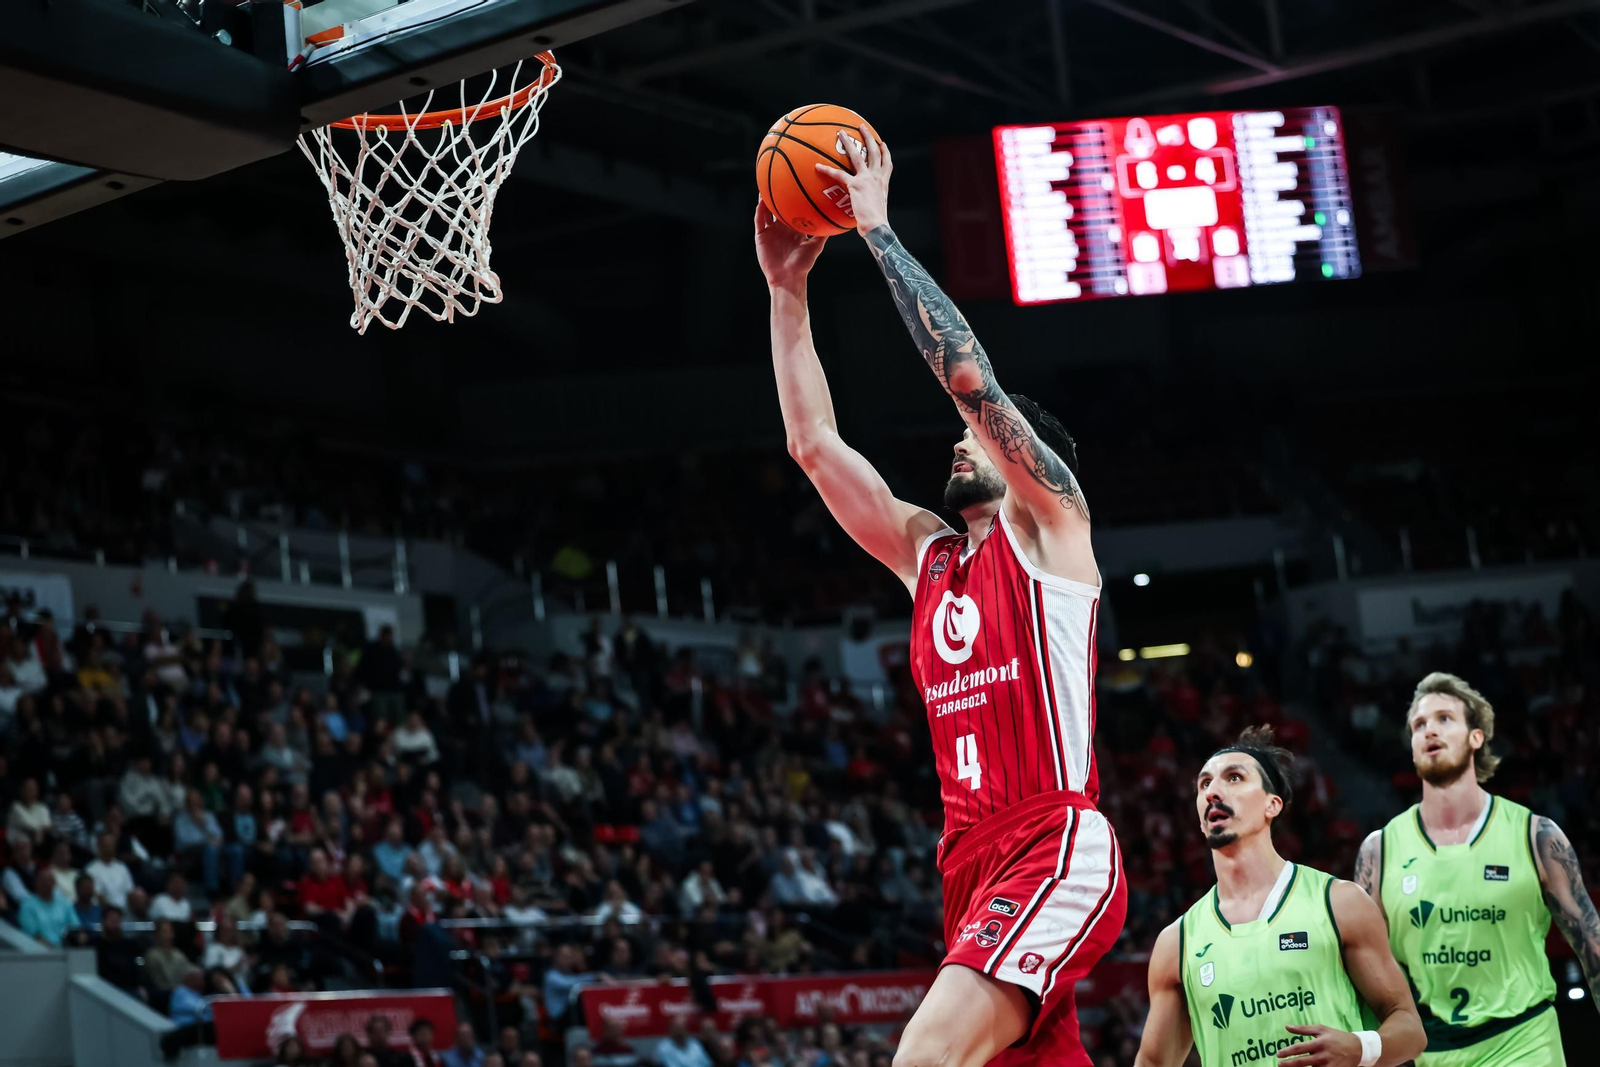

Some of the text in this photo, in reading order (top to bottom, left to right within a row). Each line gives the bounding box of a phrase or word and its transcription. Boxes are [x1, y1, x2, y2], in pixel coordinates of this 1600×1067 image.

[922, 657, 1020, 704] asademont
[935, 691, 988, 718] ZARAGOZA
[955, 733, 982, 791] 4
[991, 902, 1010, 913] acb
[1440, 905, 1506, 925] Unicaja
[1240, 986, 1316, 1018] Unicaja
[1450, 987, 1470, 1022] 2
